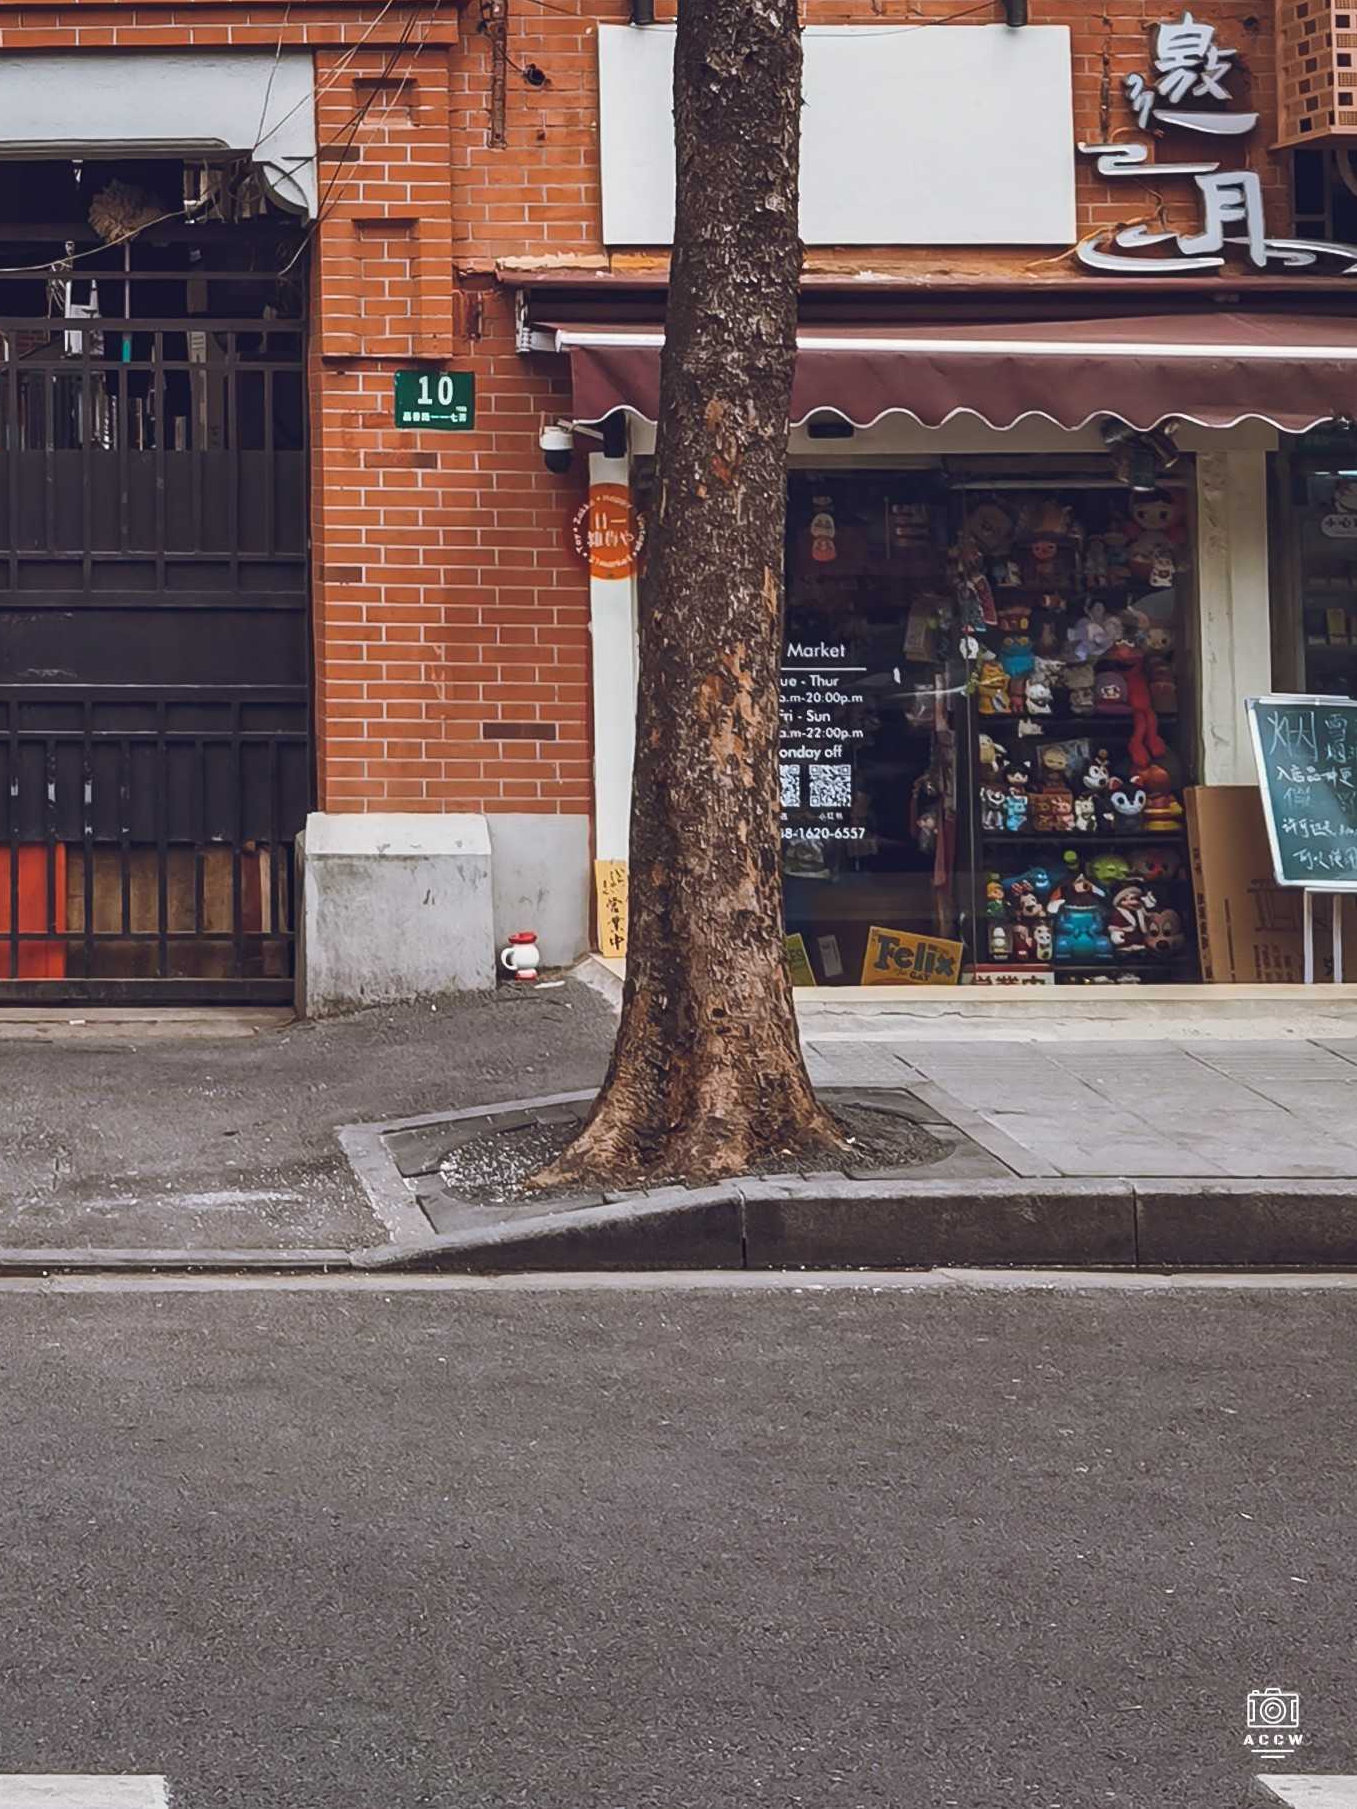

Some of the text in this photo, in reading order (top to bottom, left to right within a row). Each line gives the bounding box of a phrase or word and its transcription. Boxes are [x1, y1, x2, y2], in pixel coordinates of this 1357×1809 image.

[417, 375, 454, 406] 10
[787, 641, 846, 658] Market
[780, 677, 797, 687] ue
[809, 674, 840, 687] Thur
[779, 691, 864, 706] a.m-20:00p.m
[806, 709, 831, 722] Sun
[779, 727, 864, 741] a.m-22:00p.m
[779, 744, 843, 762] onday off
[873, 934, 956, 979] Felix
